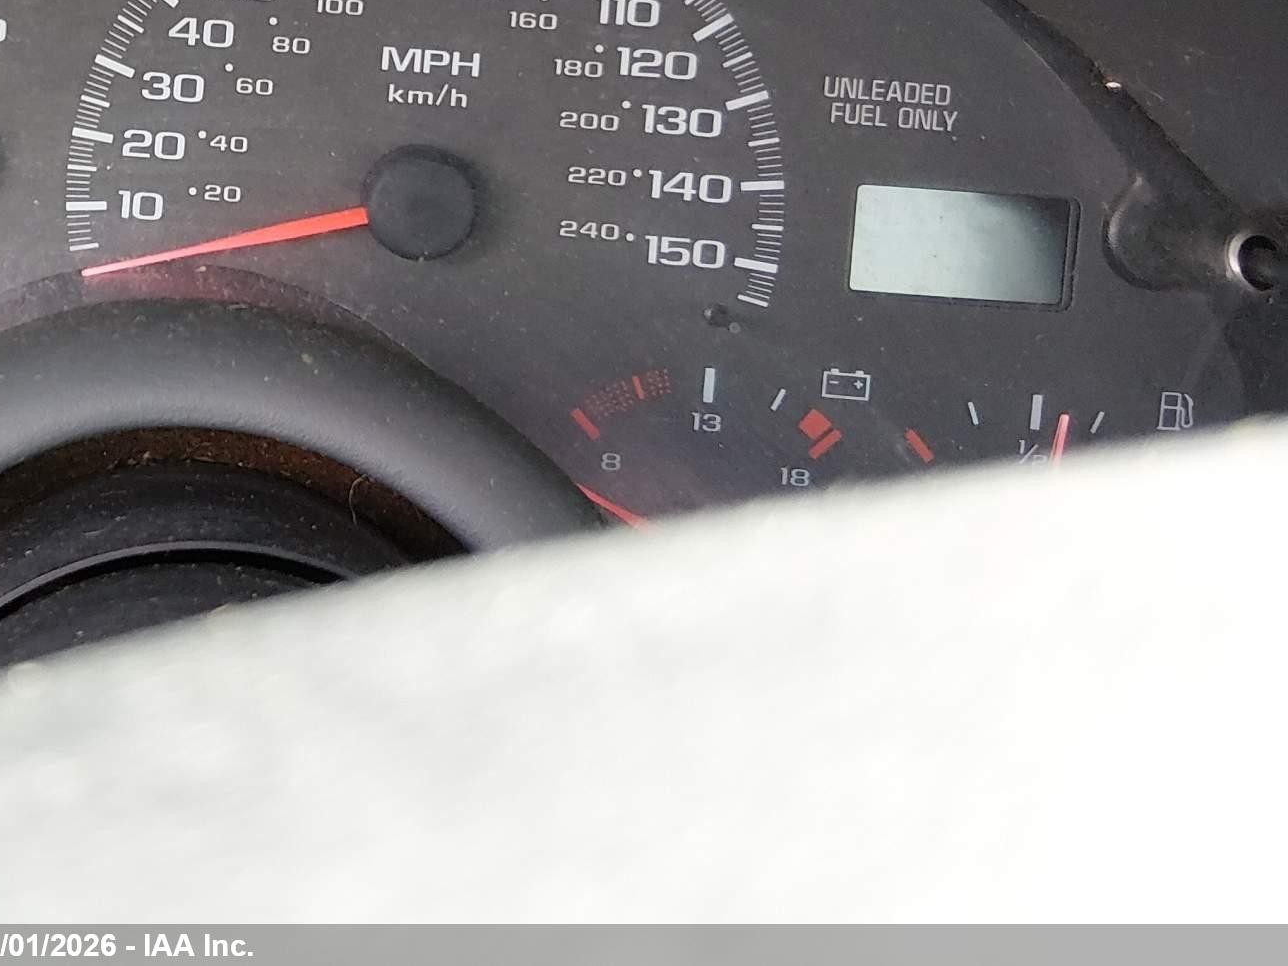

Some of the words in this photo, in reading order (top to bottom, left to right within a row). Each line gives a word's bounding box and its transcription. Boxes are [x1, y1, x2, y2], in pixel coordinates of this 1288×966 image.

[511, 12, 557, 29] 160
[169, 18, 233, 47] 40
[273, 37, 310, 53] 80
[382, 47, 480, 77] MPH
[555, 59, 602, 77] 180
[618, 47, 697, 79] 120
[142, 72, 204, 102] 30
[237, 78, 273, 95] 60
[389, 84, 467, 107] km/h
[824, 77, 950, 105] UNLEADED
[560, 112, 619, 130] 200
[642, 105, 722, 137] 130
[831, 103, 887, 126] FUEL
[899, 107, 957, 131] ONLY
[123, 130, 185, 159] 20
[210, 136, 247, 152] 40
[569, 167, 626, 185] 220
[649, 170, 731, 203] 140
[205, 185, 240, 202] 20
[119, 191, 163, 220] 10
[560, 221, 619, 240] 240
[645, 236, 725, 268] 150
[692, 412, 721, 431] 13
[601, 453, 620, 470] 8
[781, 468, 809, 486] 18
